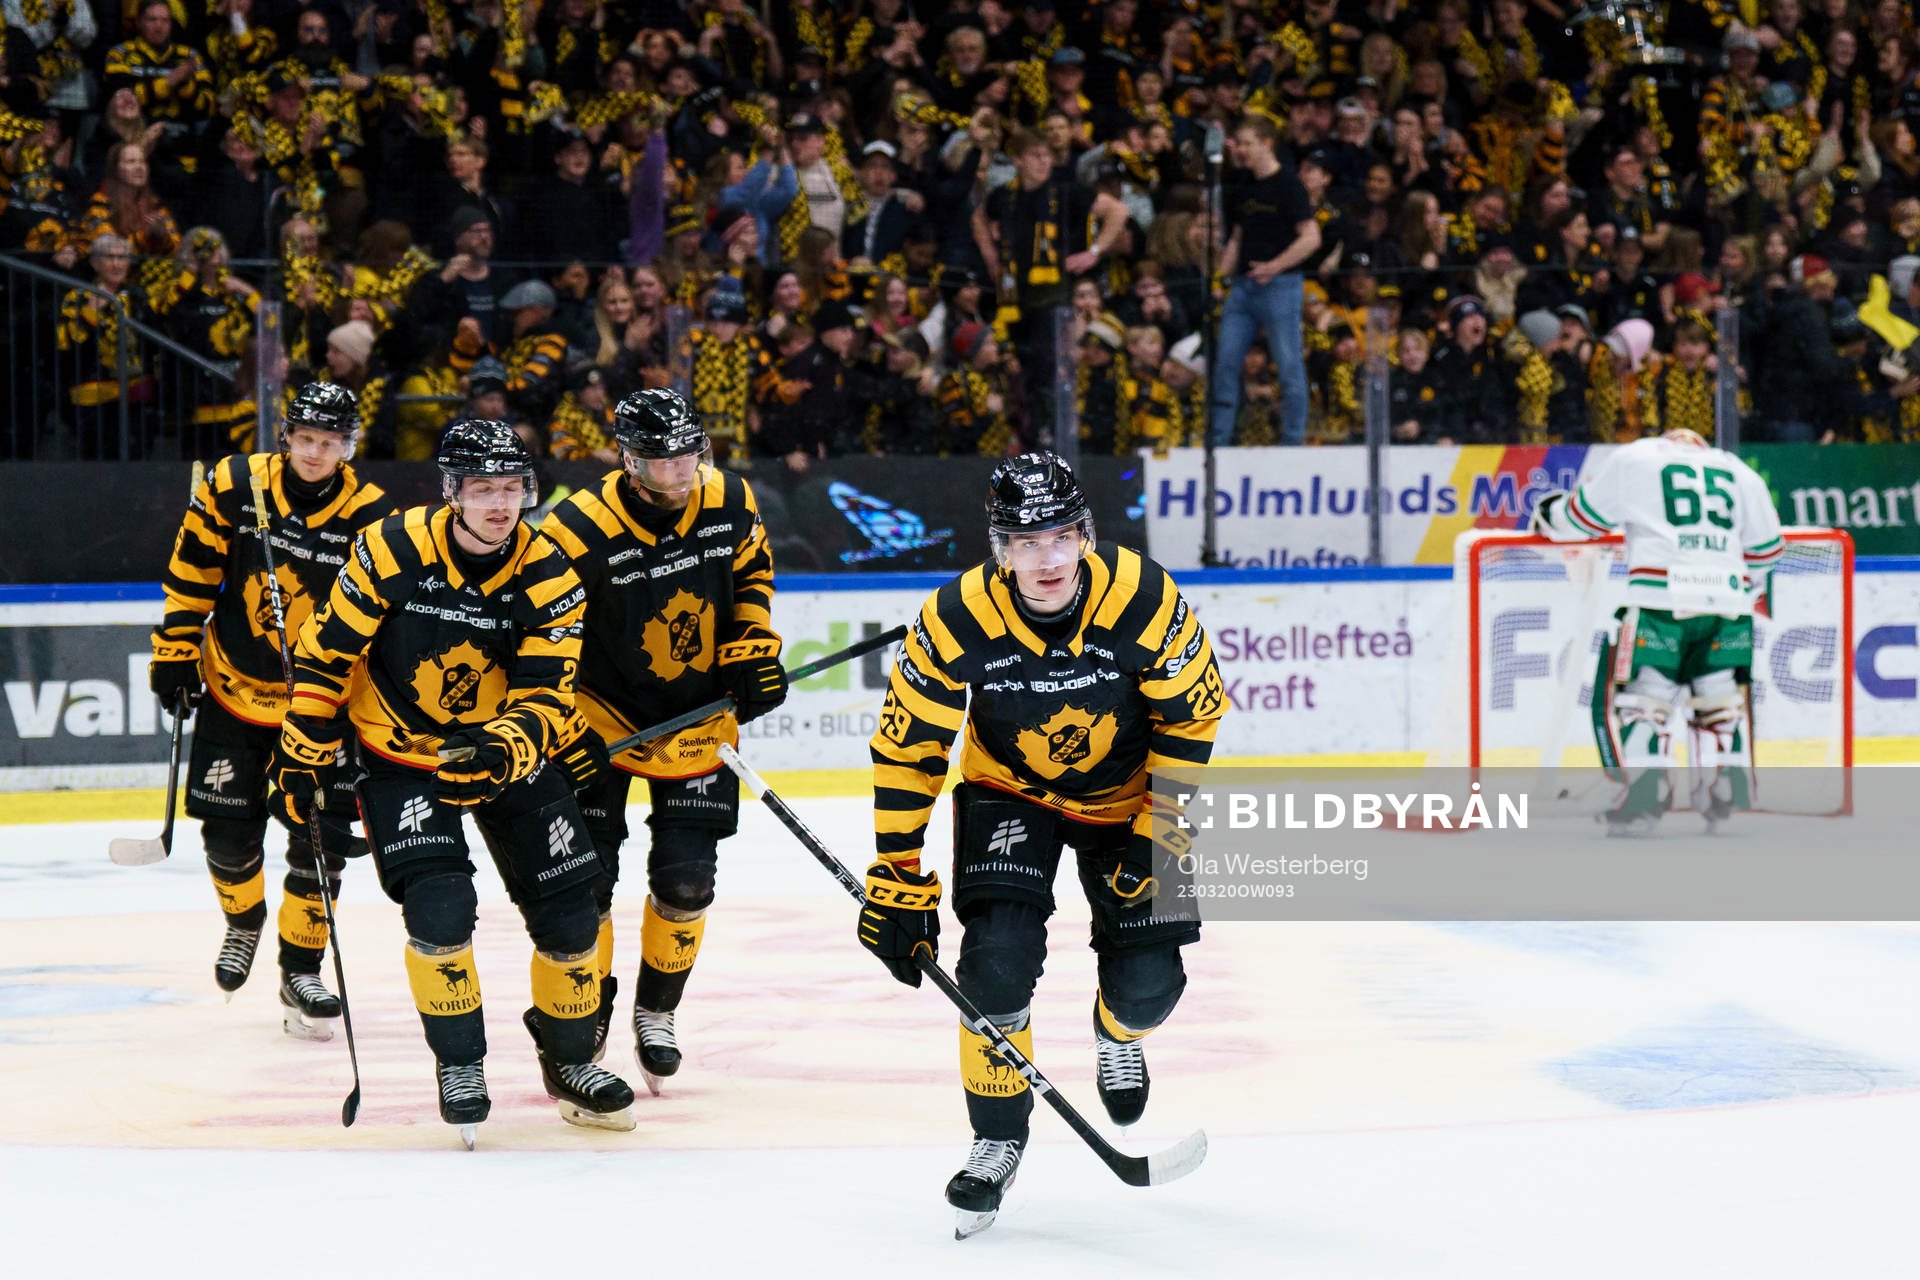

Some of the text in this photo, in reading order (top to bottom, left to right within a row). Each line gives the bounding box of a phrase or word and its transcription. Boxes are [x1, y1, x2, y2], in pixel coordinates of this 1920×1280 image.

[485, 460, 503, 473] SK
[1029, 473, 1044, 484] 29
[1661, 463, 1735, 530] 65
[1019, 507, 1042, 524] SK
[651, 555, 699, 579] BOLIDEN
[1217, 616, 1412, 662] Skellefteå
[717, 643, 772, 659] CM
[1166, 646, 1190, 678] SK
[1034, 672, 1097, 693] BOLIDEN
[1186, 663, 1223, 720] 29
[1222, 674, 1315, 712] Kraft
[251, 698, 276, 709] Kraft
[820, 712, 876, 737] BILD
[879, 688, 913, 744] 29
[282, 731, 337, 762] CCM
[678, 748, 703, 759] Kraft
[190, 787, 248, 807] martinsons
[667, 798, 732, 812] martinsons
[383, 833, 455, 856] martinsons
[537, 849, 597, 882] martinsons
[965, 858, 1044, 879] martinsons
[869, 884, 941, 907] CCM
[1119, 910, 1192, 930] martinsons
